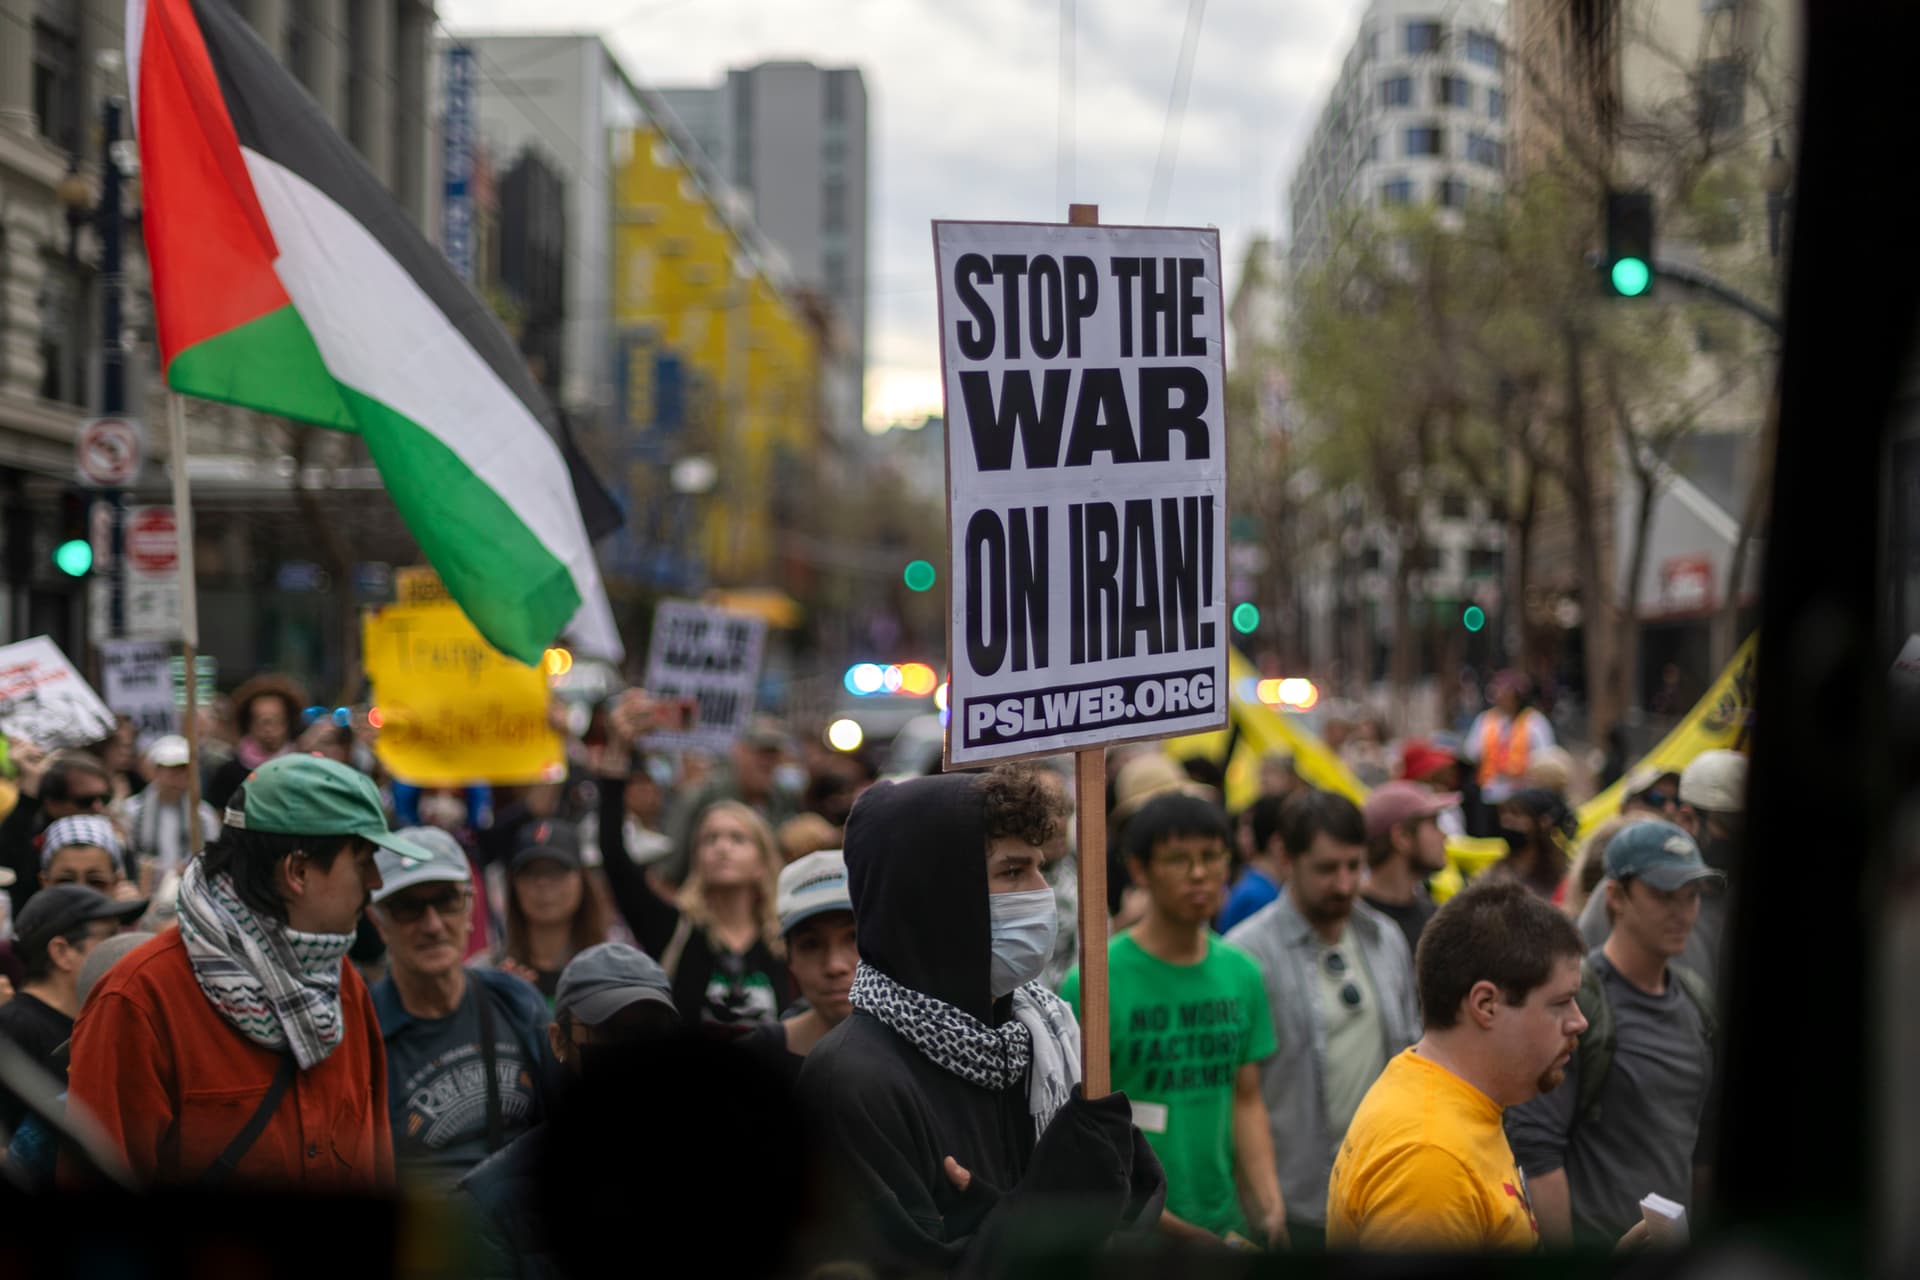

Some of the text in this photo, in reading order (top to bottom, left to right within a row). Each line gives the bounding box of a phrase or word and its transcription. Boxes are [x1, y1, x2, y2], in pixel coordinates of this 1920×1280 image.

[954, 253, 1208, 361] STOP THE
[958, 366, 1210, 472] WAR
[965, 495, 1216, 677] ON IRAN!
[967, 673, 1214, 741] PSLWEB.ORG
[1131, 998, 1242, 1031] NO MORE
